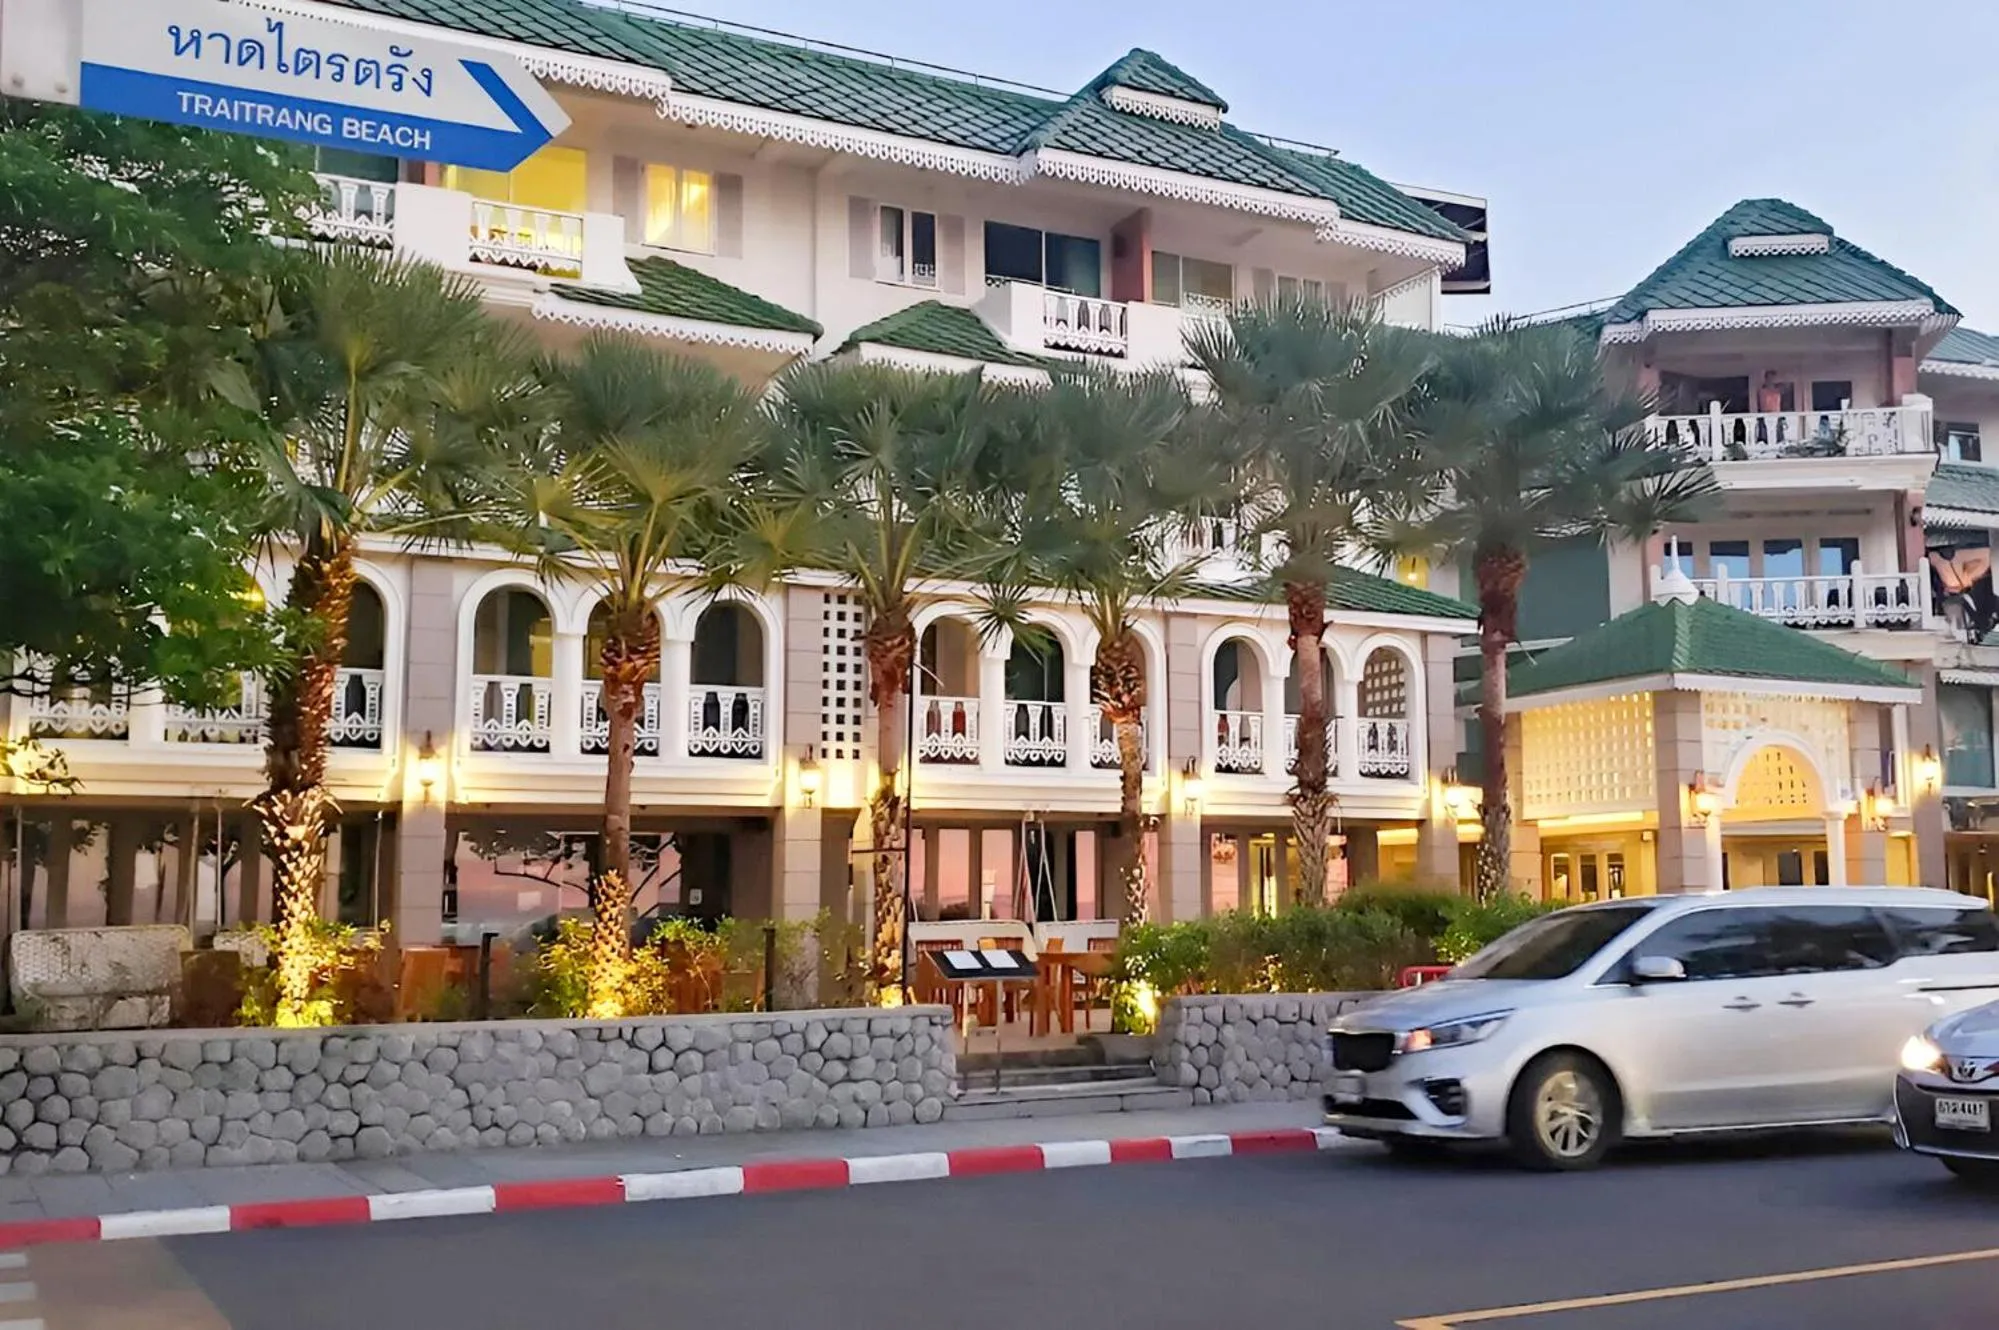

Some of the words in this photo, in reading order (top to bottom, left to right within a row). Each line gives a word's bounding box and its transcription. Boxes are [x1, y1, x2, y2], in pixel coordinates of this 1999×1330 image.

[167, 17, 433, 98] หาดไตรตรัง
[176, 90, 333, 135] TRAITRANG
[341, 117, 431, 151] BEACH
